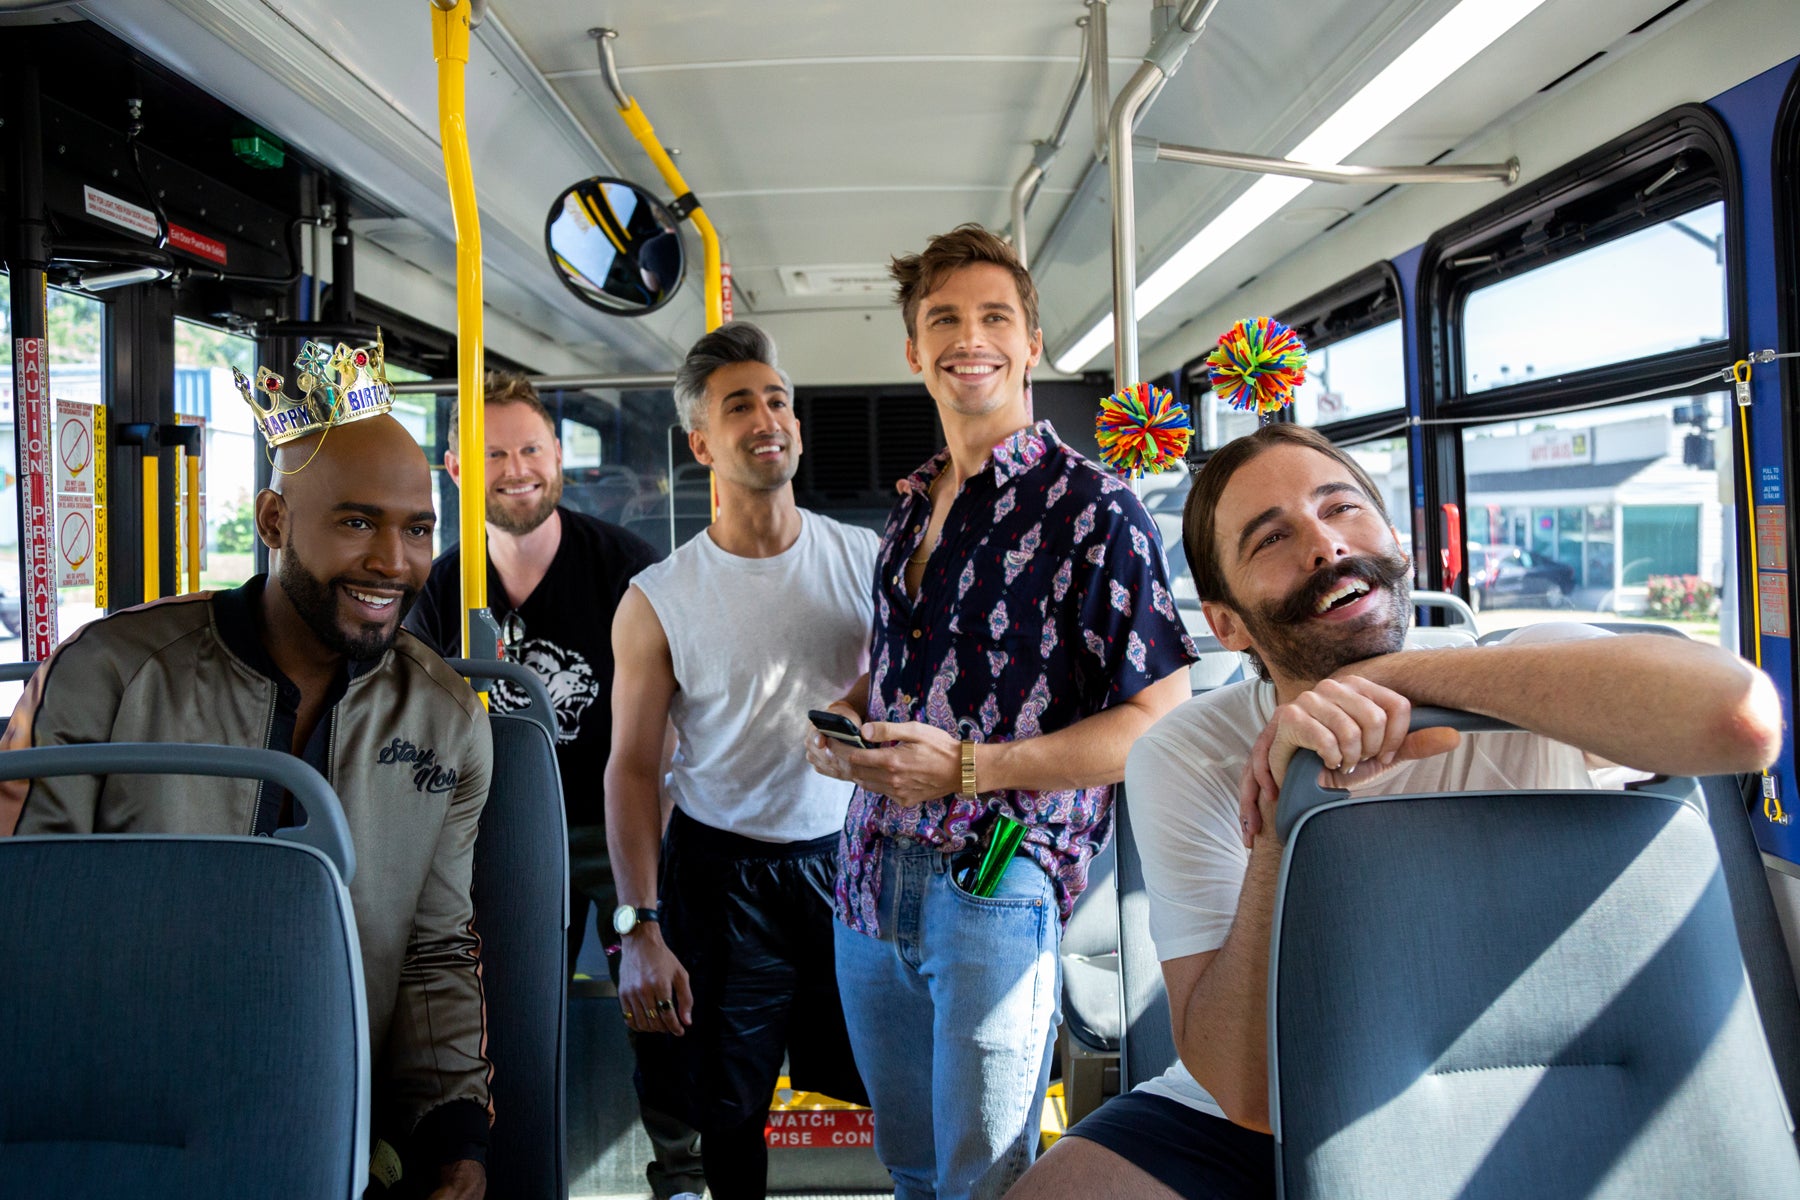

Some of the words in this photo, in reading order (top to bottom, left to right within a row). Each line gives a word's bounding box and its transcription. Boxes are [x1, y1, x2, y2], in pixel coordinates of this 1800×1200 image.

[24, 340, 43, 472] CAUTION
[263, 405, 311, 436] HAPPY
[26, 538, 31, 549] DE
[47, 537, 52, 548] DE
[26, 553, 32, 565] LA
[48, 553, 53, 564] LA
[32, 506, 49, 661] PRECAUCI
[377, 738, 435, 769] Stay
[769, 1114, 836, 1127] WATCH
[769, 1132, 812, 1145] PISE
[832, 1132, 871, 1145] CON
